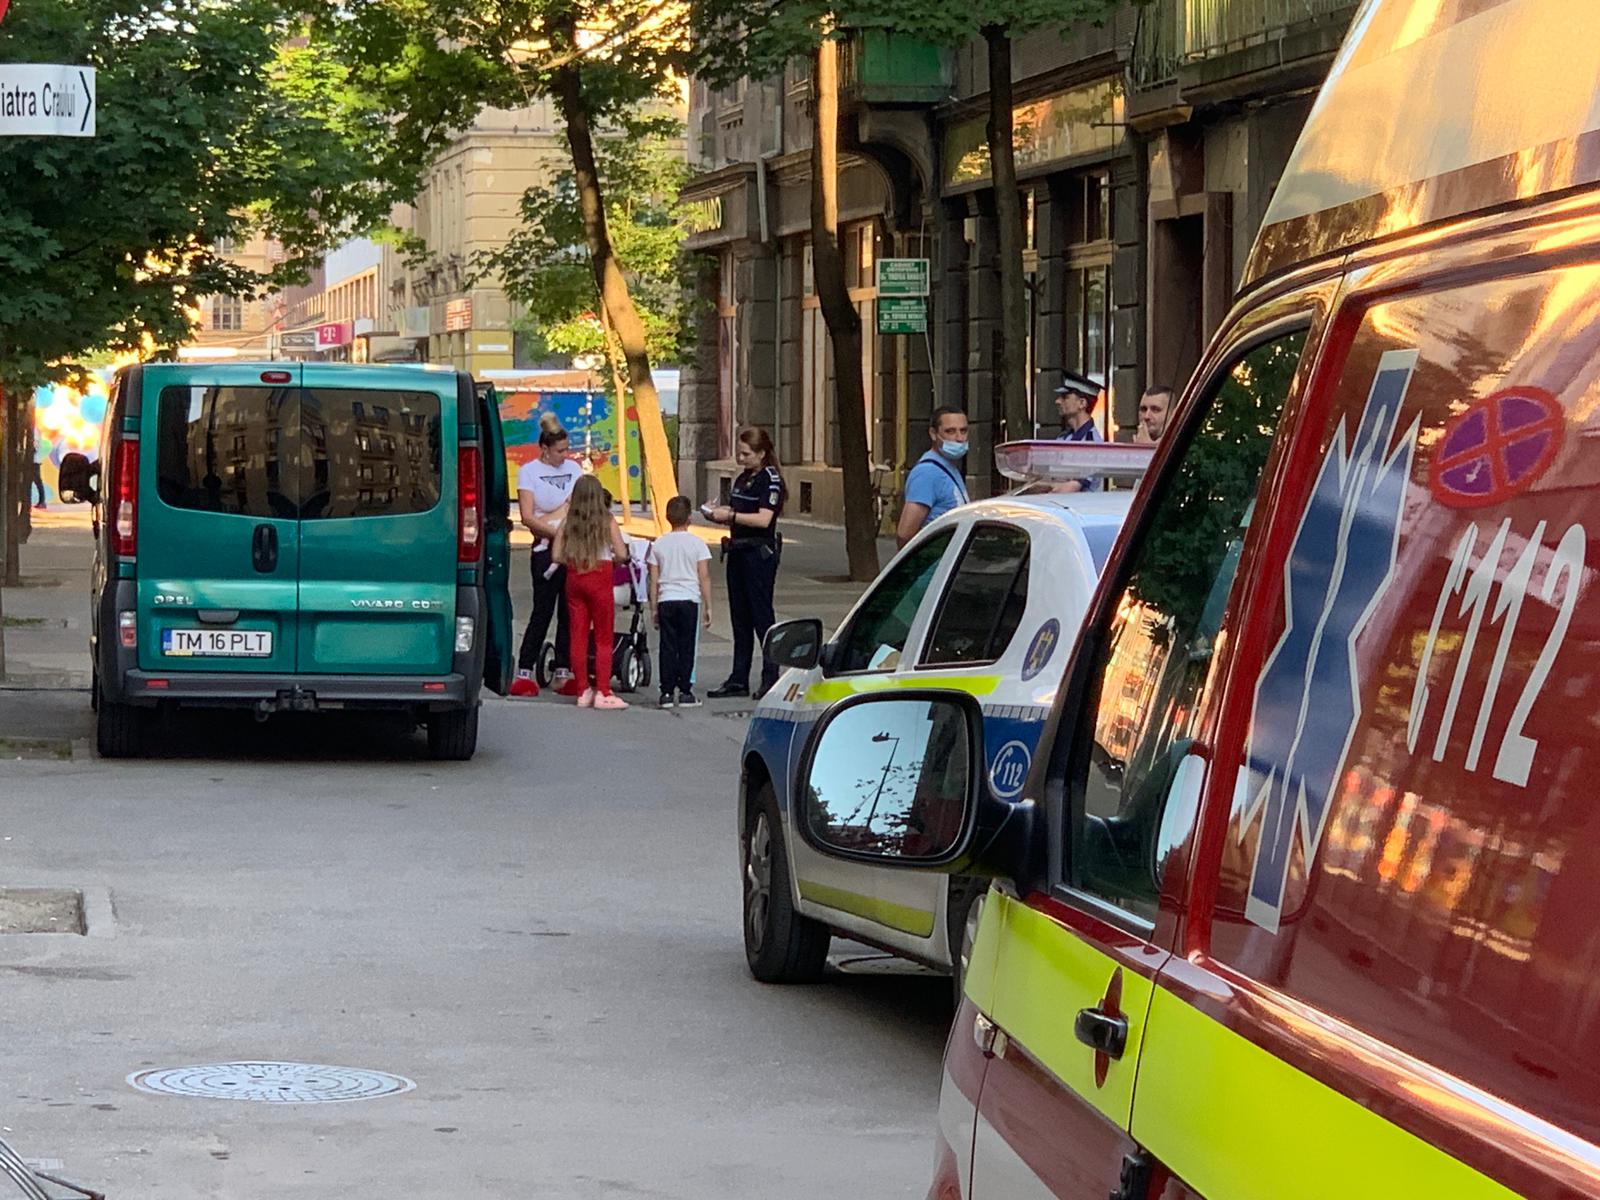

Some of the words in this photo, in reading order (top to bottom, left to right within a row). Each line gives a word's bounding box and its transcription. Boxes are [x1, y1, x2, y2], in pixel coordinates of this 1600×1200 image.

[153, 594, 195, 606] OPEL
[350, 599, 404, 609] VIVARO
[176, 632, 202, 650] TM
[208, 633, 226, 650] 16
[230, 633, 266, 651] PLT
[1001, 761, 1023, 788] 112
